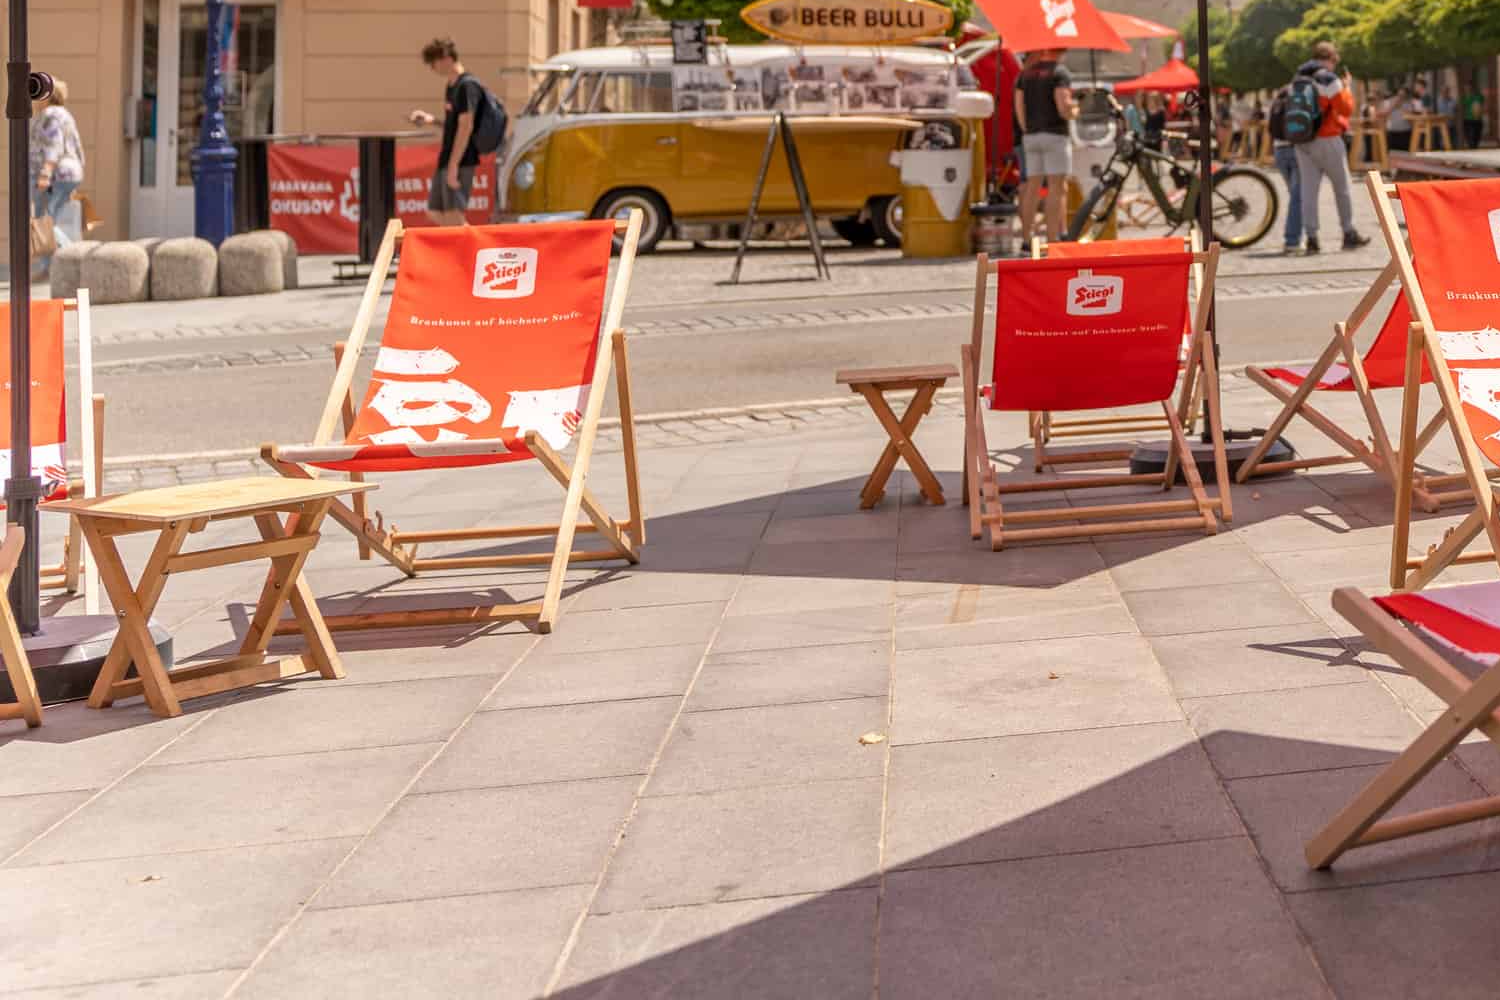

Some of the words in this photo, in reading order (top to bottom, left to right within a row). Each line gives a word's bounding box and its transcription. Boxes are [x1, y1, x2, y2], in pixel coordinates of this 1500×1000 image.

[801, 8, 857, 27] BEER
[864, 8, 925, 27] BULLI
[482, 261, 527, 285] Stiegl
[1074, 285, 1115, 304] Stiegl
